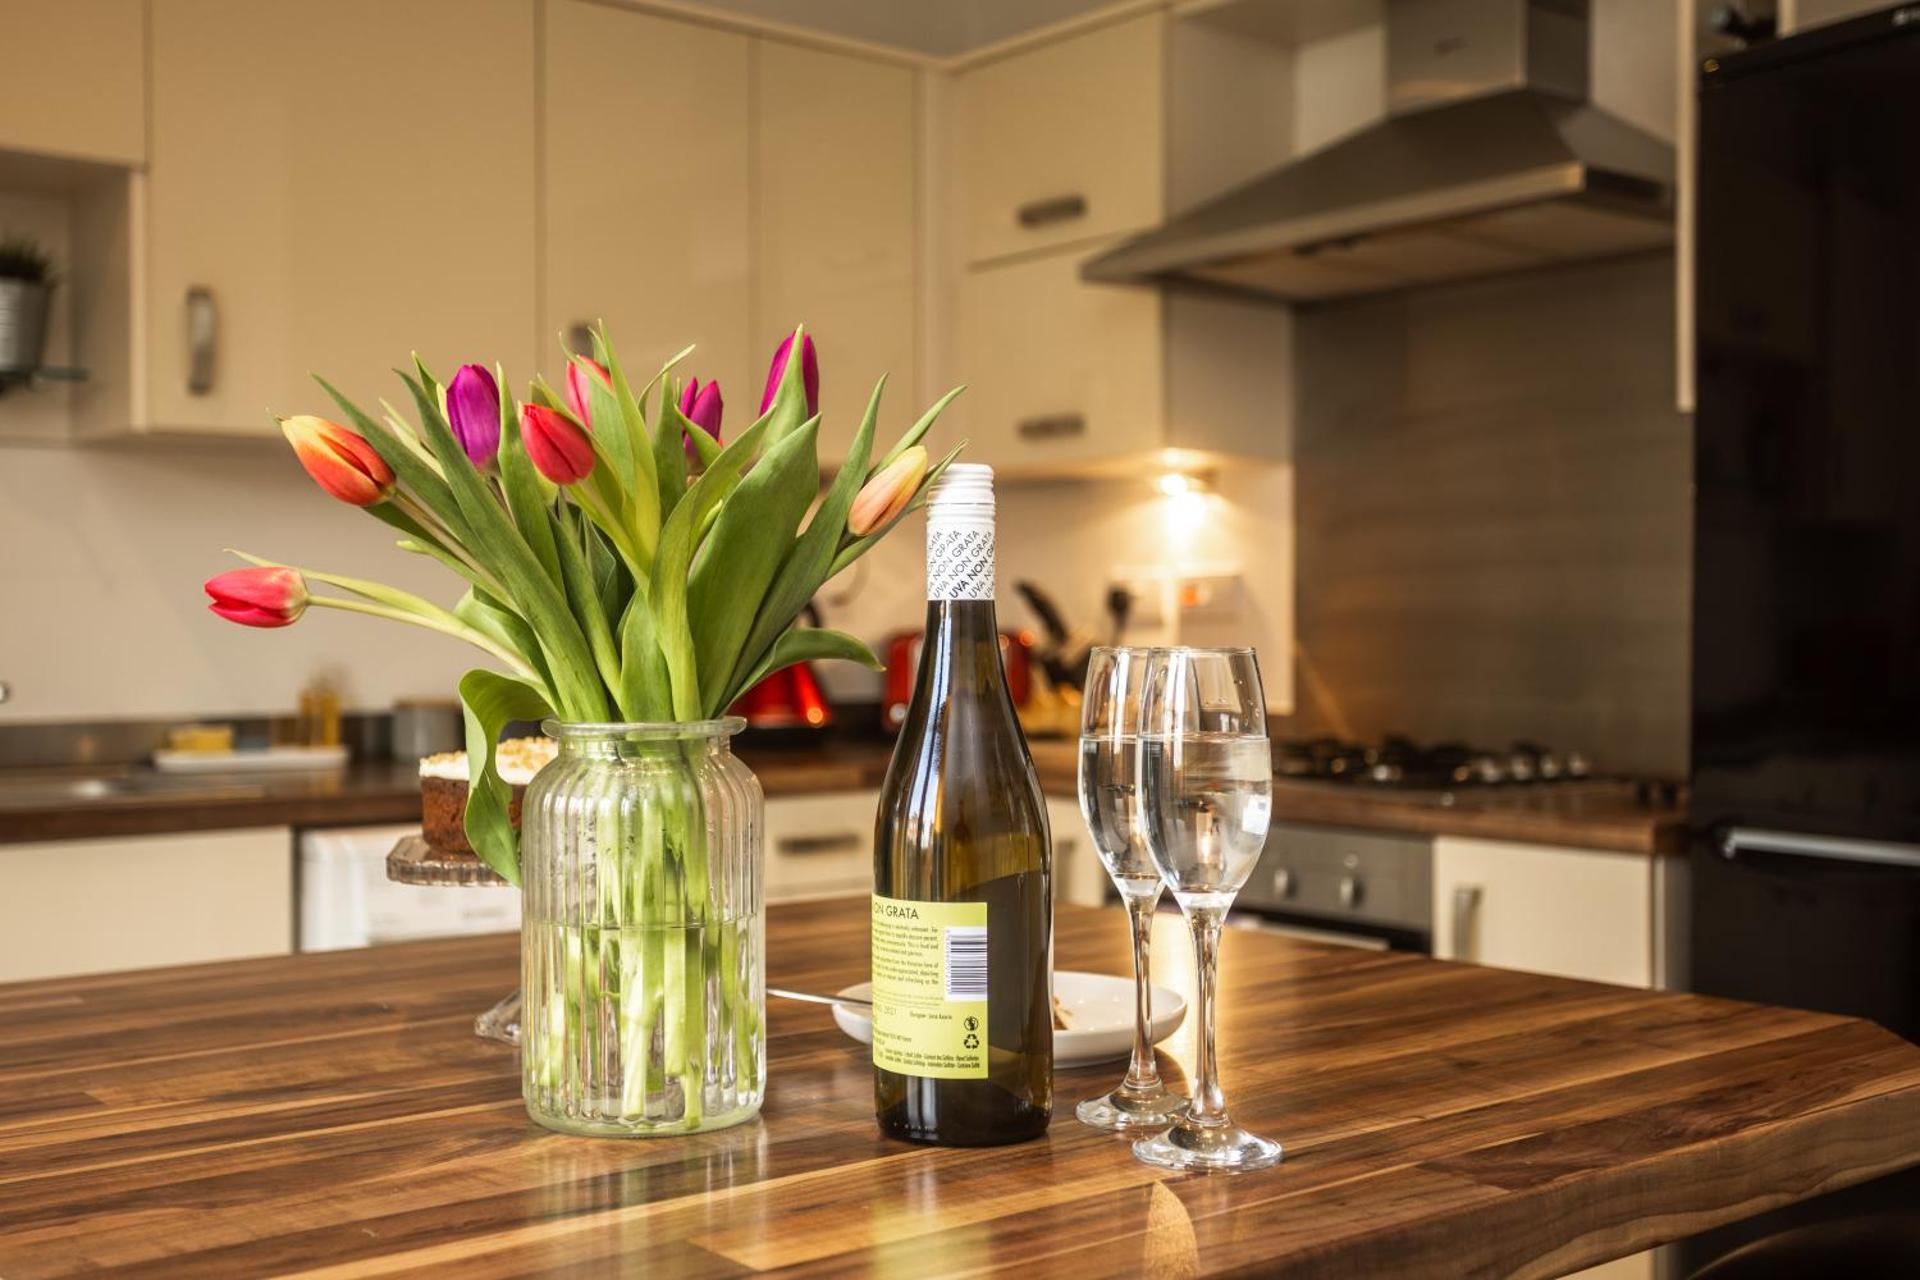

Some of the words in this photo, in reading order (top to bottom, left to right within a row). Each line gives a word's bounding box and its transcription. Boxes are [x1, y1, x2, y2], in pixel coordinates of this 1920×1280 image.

[952, 530, 980, 557] GRATA
[948, 556, 972, 581] NON
[949, 580, 970, 598] UVA
[966, 556, 988, 581] NON
[968, 580, 986, 598] UVA
[885, 905, 920, 920] GRATA
